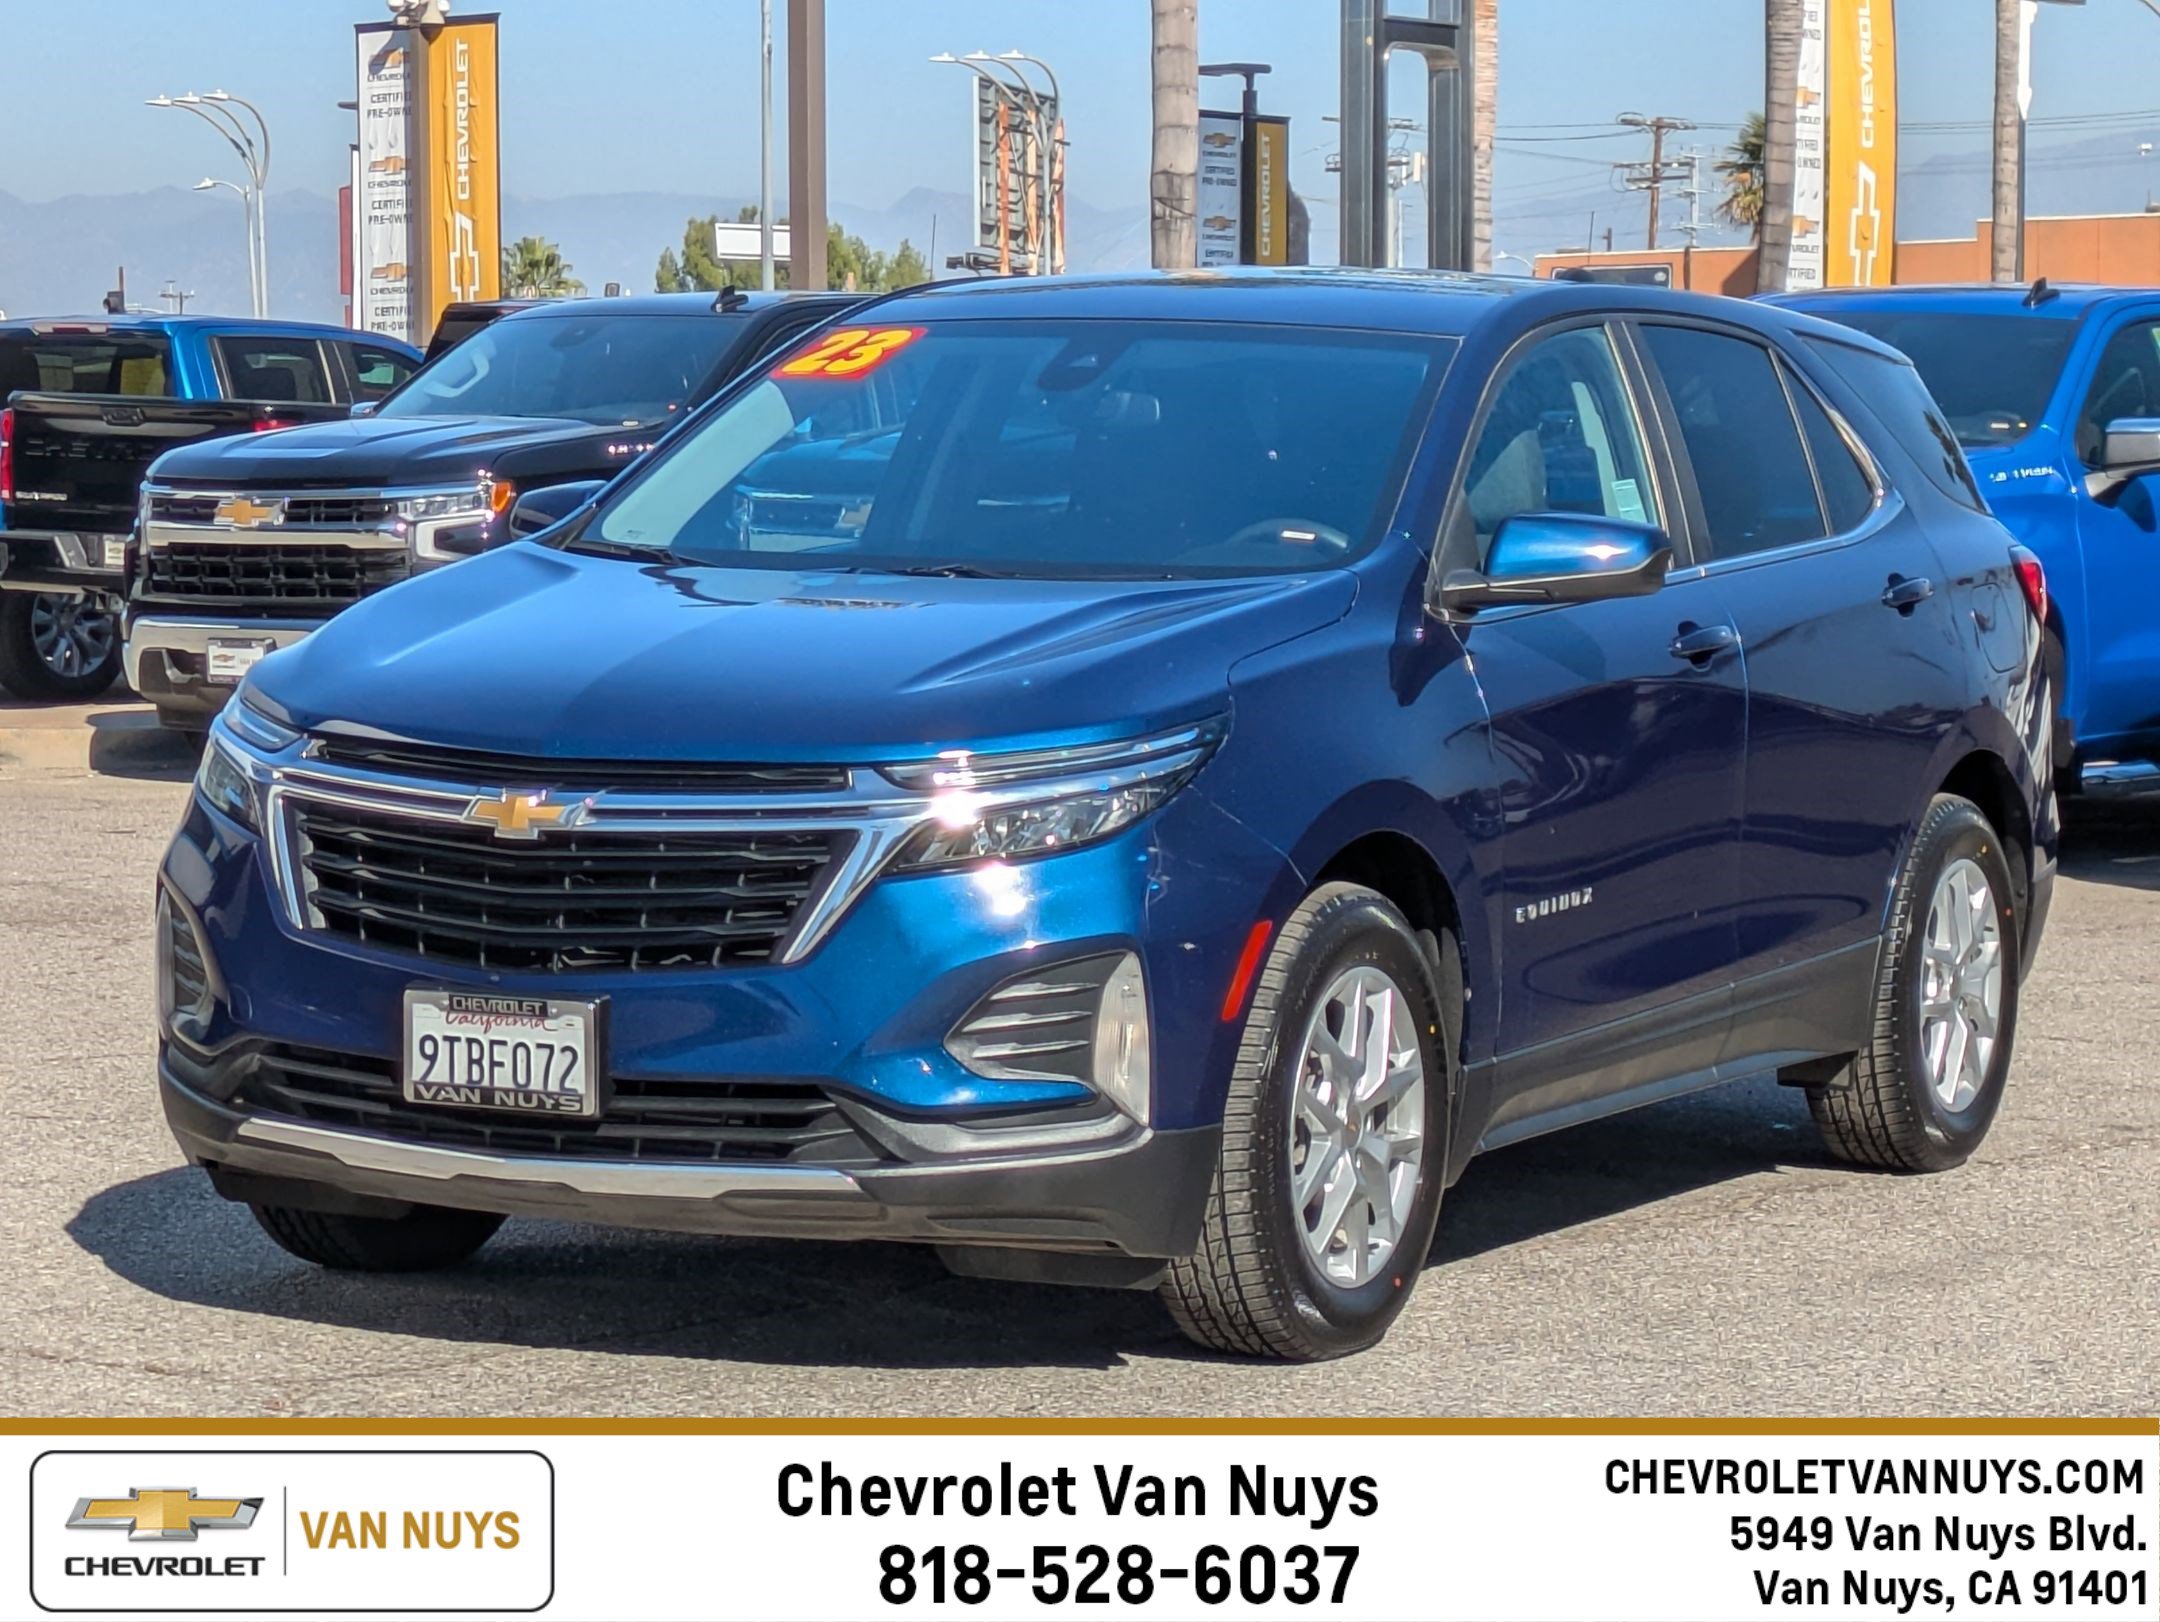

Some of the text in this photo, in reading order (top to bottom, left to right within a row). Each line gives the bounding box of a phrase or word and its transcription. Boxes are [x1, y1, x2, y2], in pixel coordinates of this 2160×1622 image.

[1857, 0, 1874, 149] CHEVROL
[456, 38, 470, 199] CHEVROLET
[1262, 132, 1271, 257] CHEVROLET
[781, 329, 913, 375] 23
[1516, 886, 1593, 924] EQUINOX
[452, 996, 544, 1016] CHEVROLET
[418, 1033, 579, 1094] 9TBF072
[415, 1084, 582, 1112] VAN NUYS
